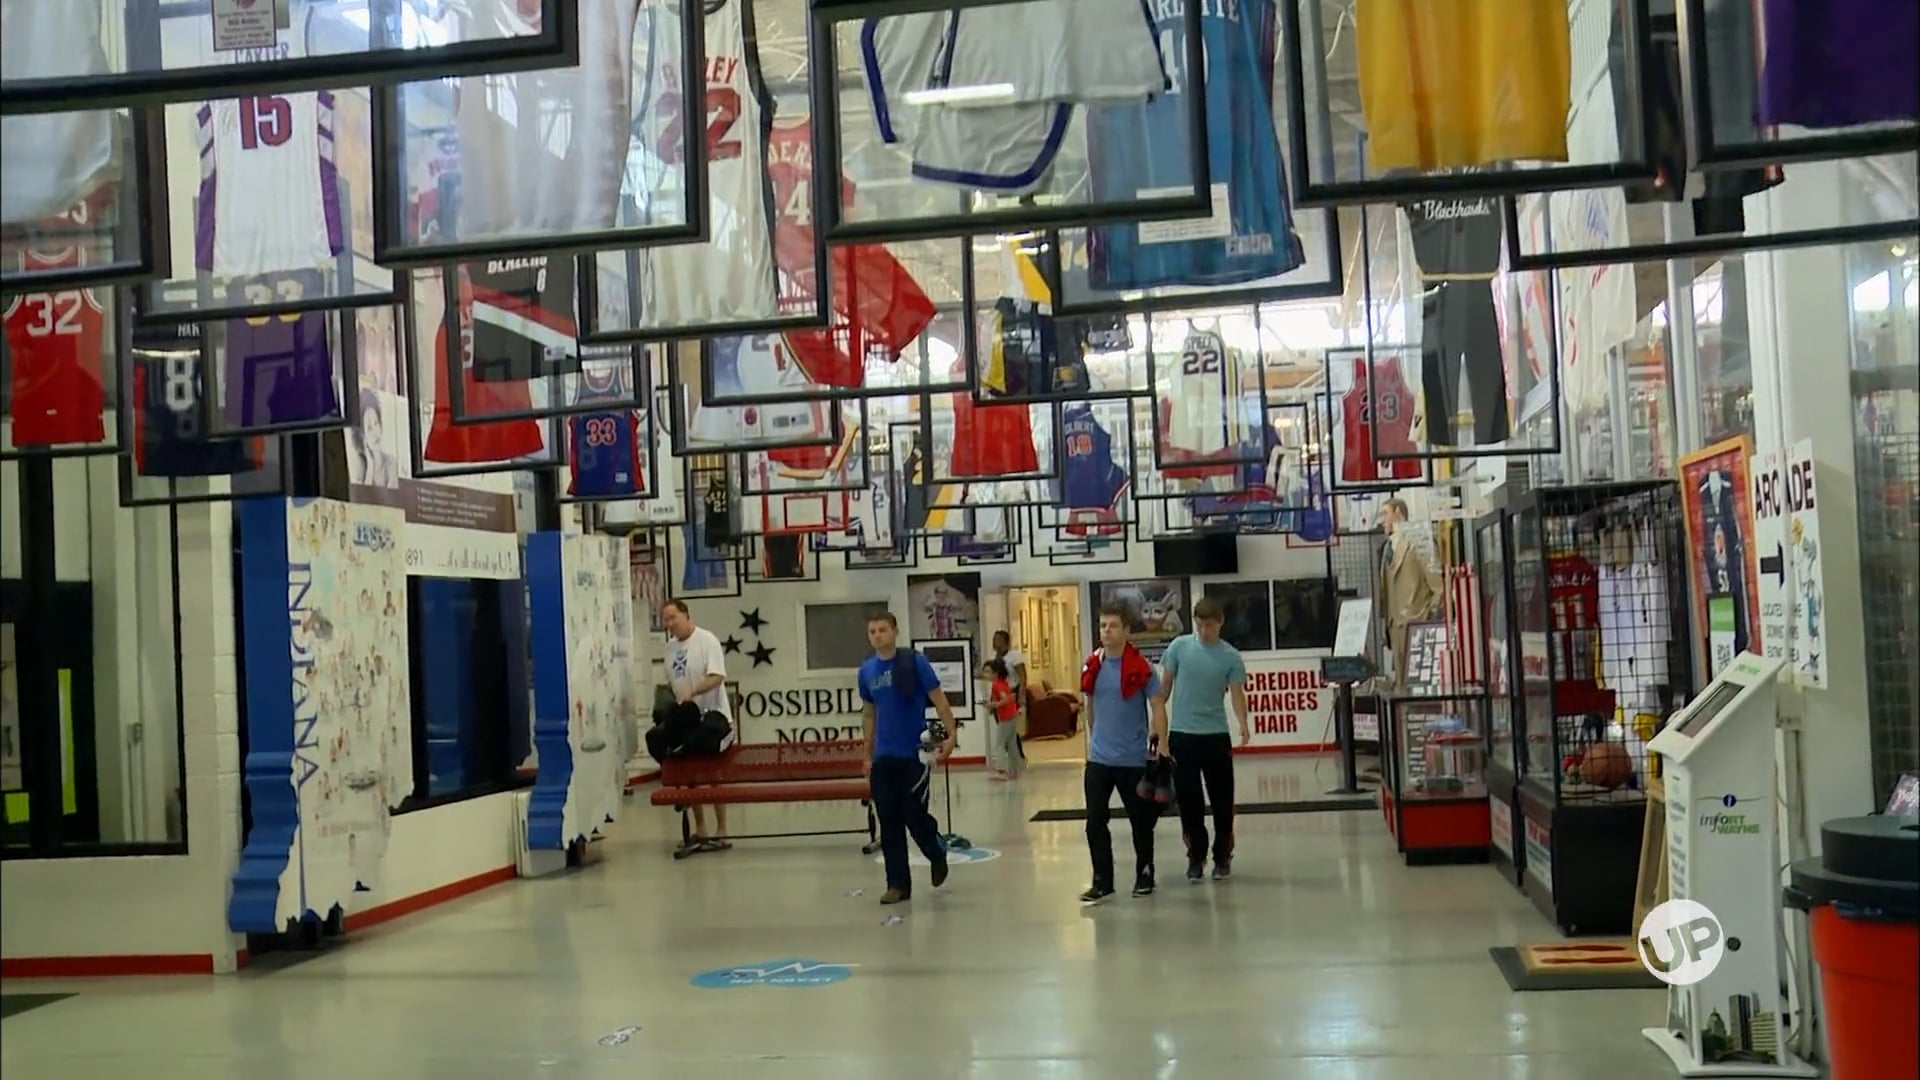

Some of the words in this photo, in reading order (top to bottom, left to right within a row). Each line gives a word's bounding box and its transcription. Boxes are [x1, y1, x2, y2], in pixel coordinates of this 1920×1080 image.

[239, 95, 292, 150] 15
[25, 290, 83, 337] 32
[1182, 349, 1219, 376] 22
[166, 357, 194, 411] 8
[586, 418, 617, 447] 33
[288, 561, 320, 788] INDIANA
[1247, 691, 1319, 713] HANGES
[1254, 713, 1298, 734] HAIR
